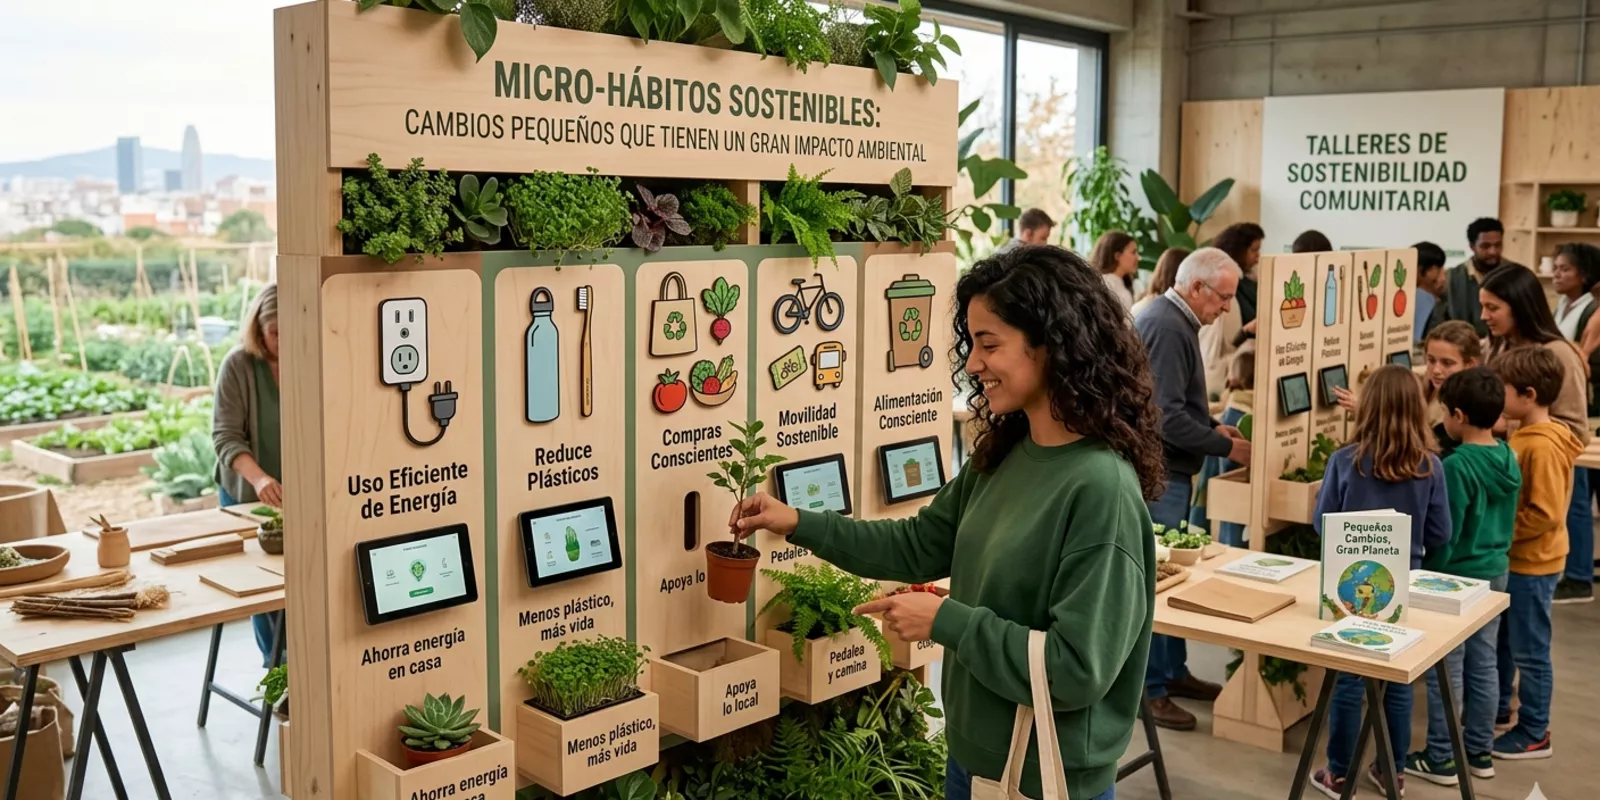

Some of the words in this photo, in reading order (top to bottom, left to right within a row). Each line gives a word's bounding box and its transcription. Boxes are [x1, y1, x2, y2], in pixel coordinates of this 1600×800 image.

[495, 59, 720, 114] MICRO-HÁBITOS
[729, 83, 881, 128] SOSTENIBLES:
[405, 108, 504, 138] CAMBIOS
[512, 114, 615, 145] PEQUEÑOS
[620, 121, 656, 148] QUE
[661, 125, 719, 152] TIENEN
[725, 130, 746, 153] UN
[750, 132, 790, 156] GRAN
[794, 135, 854, 158] IMPACTO
[857, 139, 927, 162] AMBIENTAL
[1306, 133, 1410, 155] TALLERES
[1419, 132, 1448, 154] DE
[1287, 161, 1467, 183] SOSTENIBILIDAD
[1300, 190, 1450, 211] COMUNITARIA
[874, 387, 942, 412] Alimentación
[779, 404, 836, 427] Movilidad
[879, 409, 938, 430] Consciente
[662, 424, 722, 446] Compras
[776, 422, 839, 448] Sostenible
[535, 443, 592, 466] Reduce
[651, 443, 733, 470] Conscientes
[348, 475, 384, 496] Uso
[389, 461, 469, 490] Eficiente
[527, 463, 599, 491] Plásticos
[361, 498, 384, 519] de
[389, 485, 457, 515] Energía
[1336, 544, 1360, 555] Gran
[1362, 544, 1400, 556] Planeta
[1345, 533, 1391, 545] Cambios,
[660, 571, 693, 593] Apoya
[518, 606, 560, 628] Menos
[564, 592, 615, 617] plástico,
[540, 621, 566, 642] más
[569, 616, 595, 634] vida
[361, 642, 410, 666] Ahorra
[414, 627, 466, 654] energía
[830, 645, 865, 664] Pedalea
[388, 664, 406, 680] en
[409, 656, 442, 675] casa
[828, 671, 835, 684] y
[836, 659, 867, 679] camina
[725, 676, 757, 699] Apoya
[723, 701, 732, 716] lo
[734, 692, 759, 713] local
[567, 734, 606, 757] Menos
[609, 717, 657, 743] plástico,
[587, 749, 612, 768] más
[613, 739, 638, 757] vida
[411, 783, 456, 800] Ahorra
